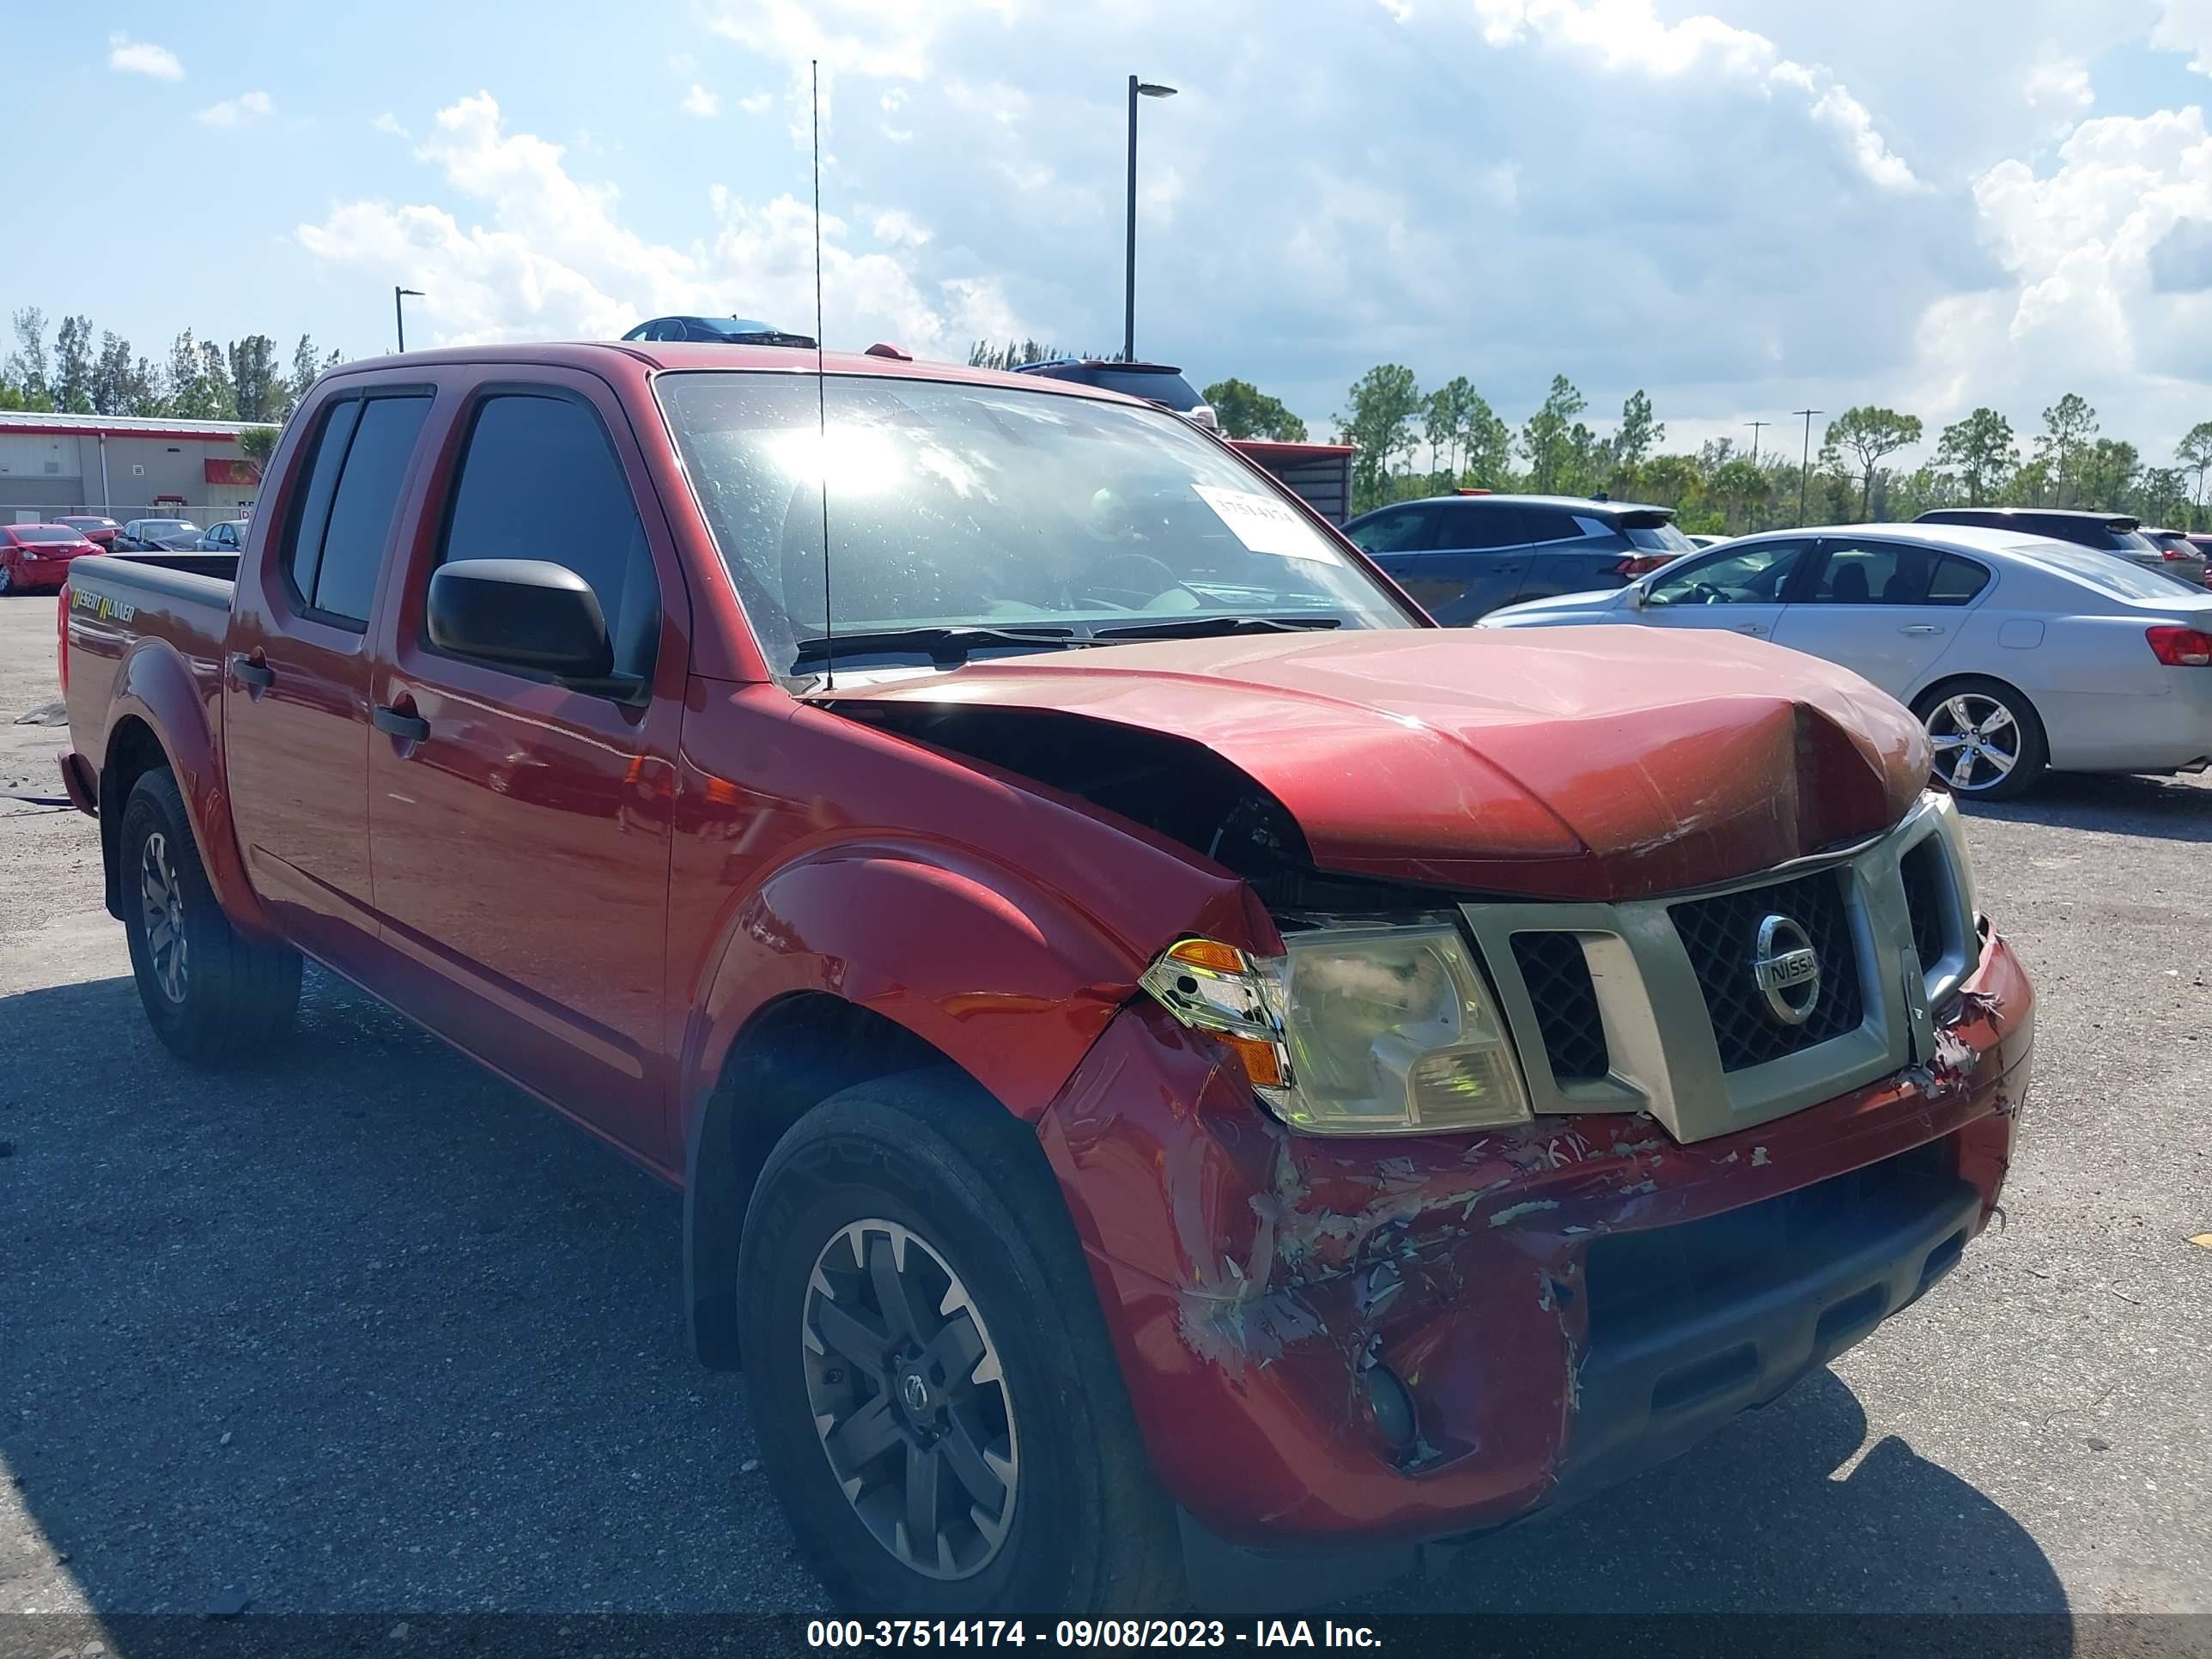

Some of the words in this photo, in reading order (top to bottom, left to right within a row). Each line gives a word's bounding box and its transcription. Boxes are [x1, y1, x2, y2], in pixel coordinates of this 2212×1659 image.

[71, 588, 101, 611] DESERT
[99, 597, 135, 623] RUNNER
[1771, 955, 1815, 983] NISSA
